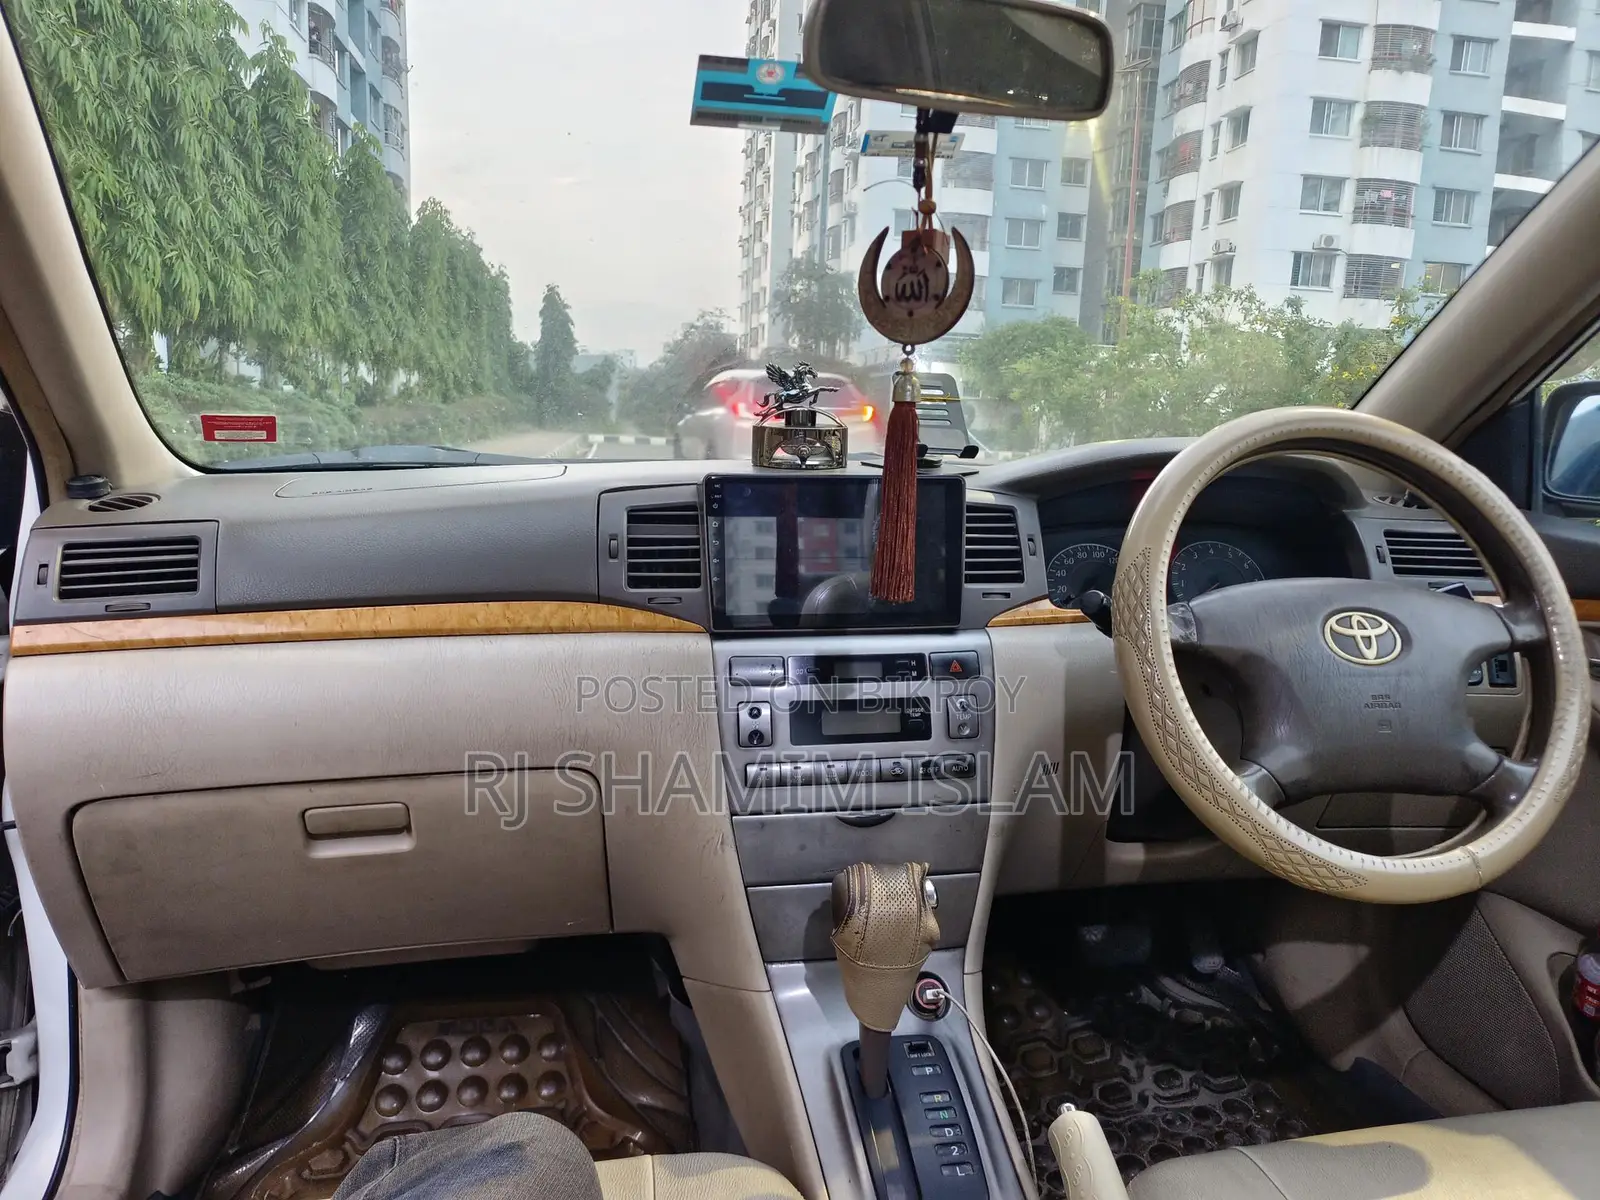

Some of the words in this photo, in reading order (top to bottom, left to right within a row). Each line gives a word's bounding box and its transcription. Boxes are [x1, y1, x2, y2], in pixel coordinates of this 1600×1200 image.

[1077, 550, 1088, 559] 80
[1092, 550, 1105, 559] 100
[1193, 551, 1198, 559] 3
[1064, 557, 1075, 566] 60
[1244, 561, 1249, 570] 6
[1181, 563, 1186, 571] 2
[1056, 569, 1067, 578] 40
[1057, 585, 1068, 594] 20
[1363, 702, 1402, 710] AIRBAG
[956, 713, 972, 721] TEMP
[925, 1067, 934, 1076] P
[934, 1094, 942, 1103] R
[939, 1110, 949, 1119] N
[944, 1127, 954, 1137] D
[950, 1146, 960, 1156] 2
[956, 1166, 965, 1176] L
